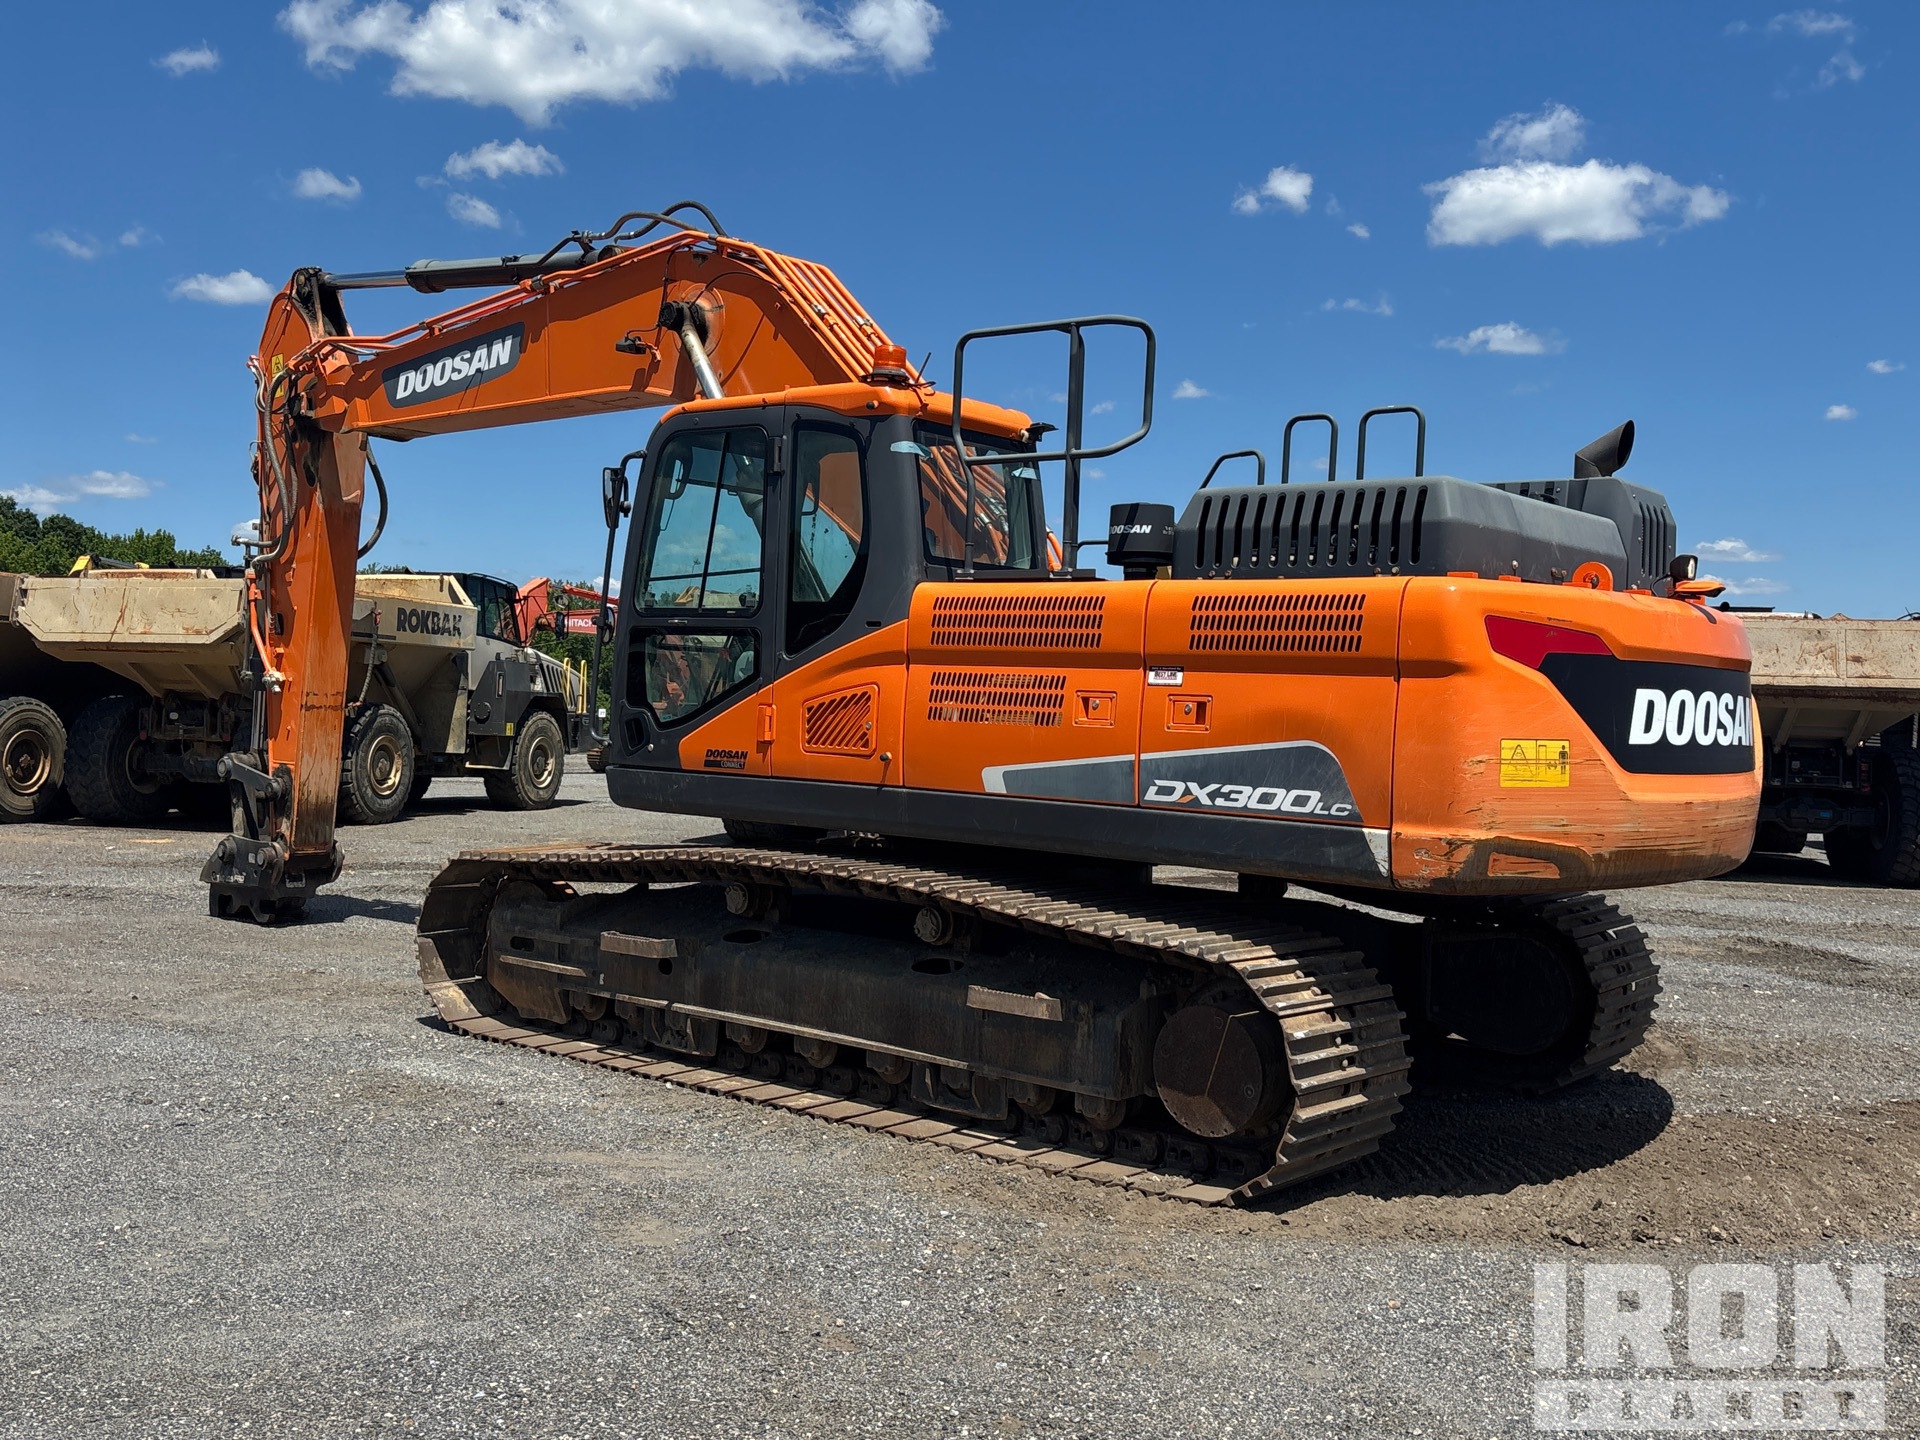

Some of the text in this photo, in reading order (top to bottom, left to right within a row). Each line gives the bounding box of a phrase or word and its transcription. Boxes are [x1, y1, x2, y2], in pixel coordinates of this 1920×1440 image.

[396, 335, 513, 400] DOOSAN
[1110, 524, 1152, 535] OOSAN
[396, 607, 463, 639] ROKBAK
[1628, 688, 1754, 747] DOOSAN
[705, 748, 749, 760] DOOSAN
